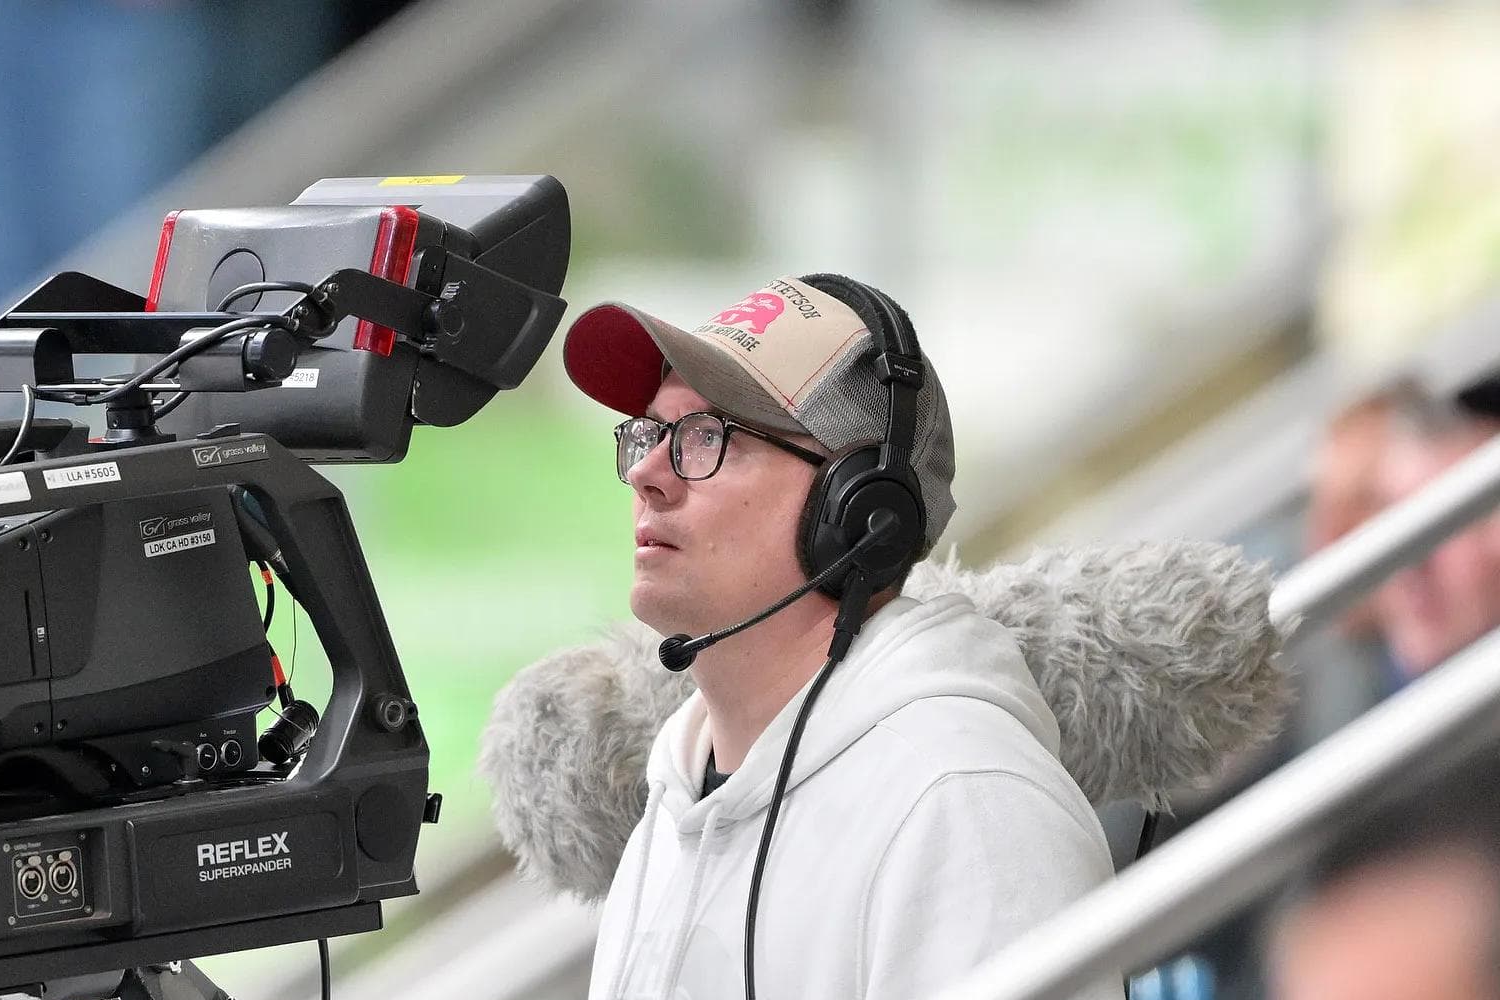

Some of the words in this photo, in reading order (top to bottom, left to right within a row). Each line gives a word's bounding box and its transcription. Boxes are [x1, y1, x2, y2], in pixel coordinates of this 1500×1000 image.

[66, 470, 84, 482] LLA
[84, 466, 116, 480] #5605
[167, 518, 189, 530] grass
[189, 512, 211, 522] valley
[149, 543, 166, 554] LDK
[166, 541, 177, 551] CA
[178, 537, 189, 548] HD
[190, 532, 211, 546] #3150
[197, 831, 291, 867] REFLEX
[199, 857, 293, 882] SUPERXPANDER
